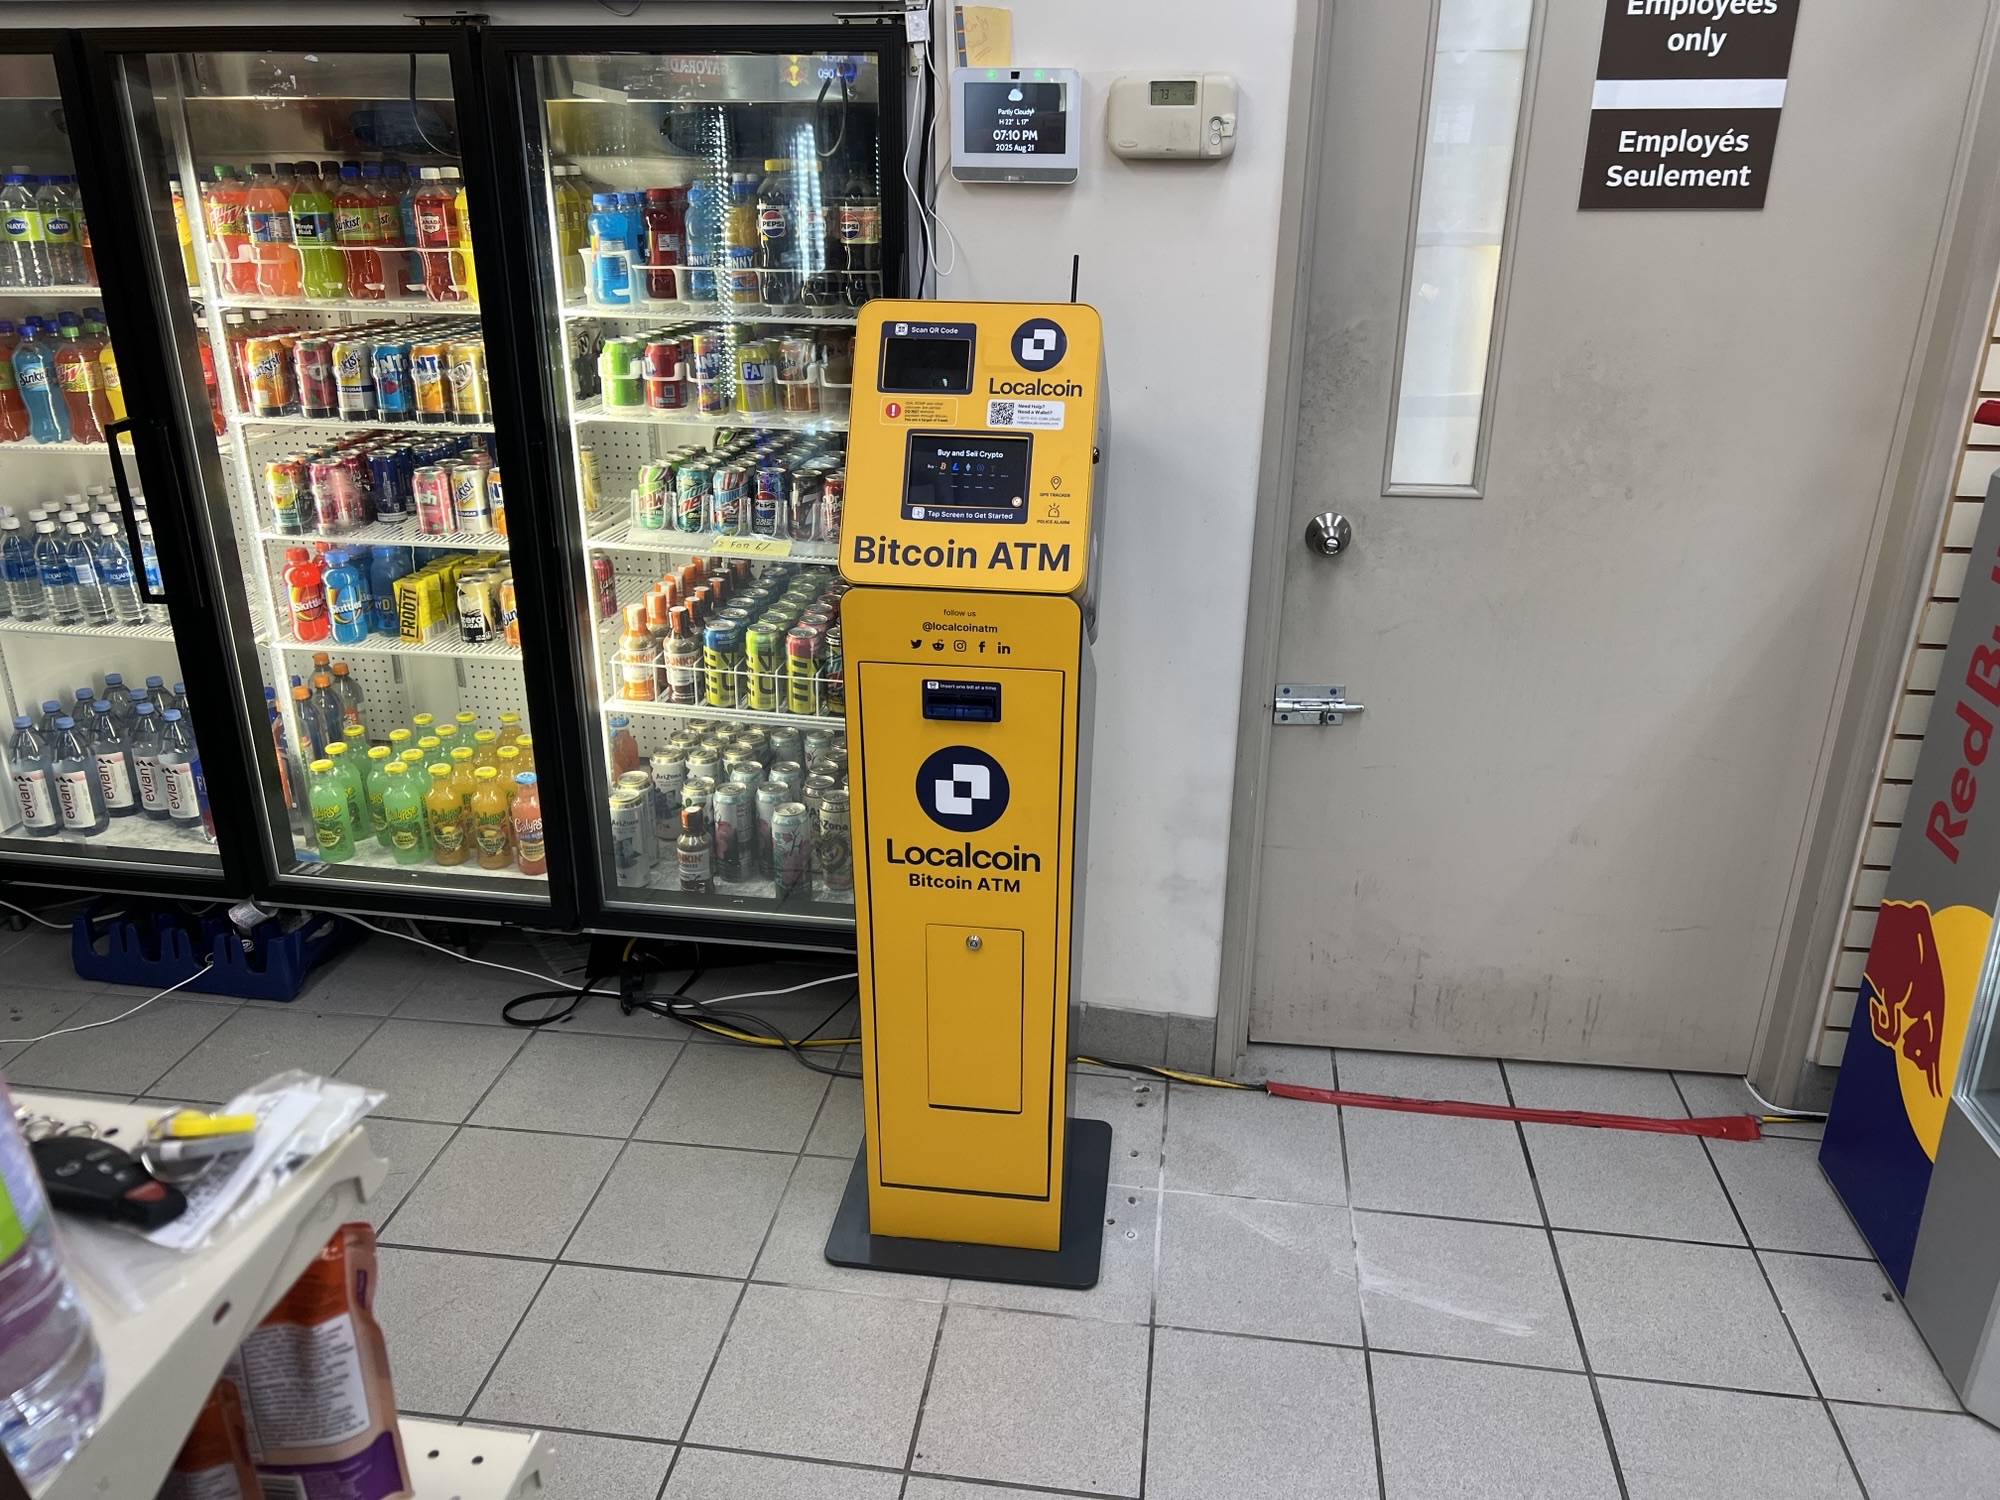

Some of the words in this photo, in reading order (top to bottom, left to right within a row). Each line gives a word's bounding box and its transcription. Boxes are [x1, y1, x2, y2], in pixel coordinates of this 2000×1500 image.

[1627, 0, 1778, 20] Employees
[1667, 26, 1727, 57] only
[1160, 89, 1169, 99] 73
[998, 108, 1013, 116] Partly
[993, 130, 1020, 141] 07:10
[1022, 130, 1038, 141] PM
[1618, 128, 1749, 157] Employés
[1014, 144, 1027, 153] Aug
[1606, 164, 1751, 187] Seulement
[841, 222, 859, 230] PEPSI
[989, 378, 1083, 398] Localcoin
[937, 449, 951, 457] Buy
[979, 451, 1004, 460] Crypto
[928, 510, 940, 518] Tap
[941, 511, 965, 519] Screen
[853, 535, 977, 568] Bitcoin
[988, 542, 1071, 571] ATM
[401, 587, 417, 638] FROOTI
[461, 616, 483, 624] zero
[943, 609, 966, 617] follow
[922, 621, 998, 633] @localcoinatm
[98, 763, 114, 800] evian
[139, 767, 156, 802] evian
[1925, 700, 1994, 865] Red
[17, 782, 35, 819] evian
[59, 783, 76, 819] evian
[165, 774, 181, 810] evian
[514, 818, 543, 833] Calyps
[887, 838, 1041, 873] Localcoin
[909, 873, 972, 890] Bitcoin
[977, 877, 1021, 893] ATM
